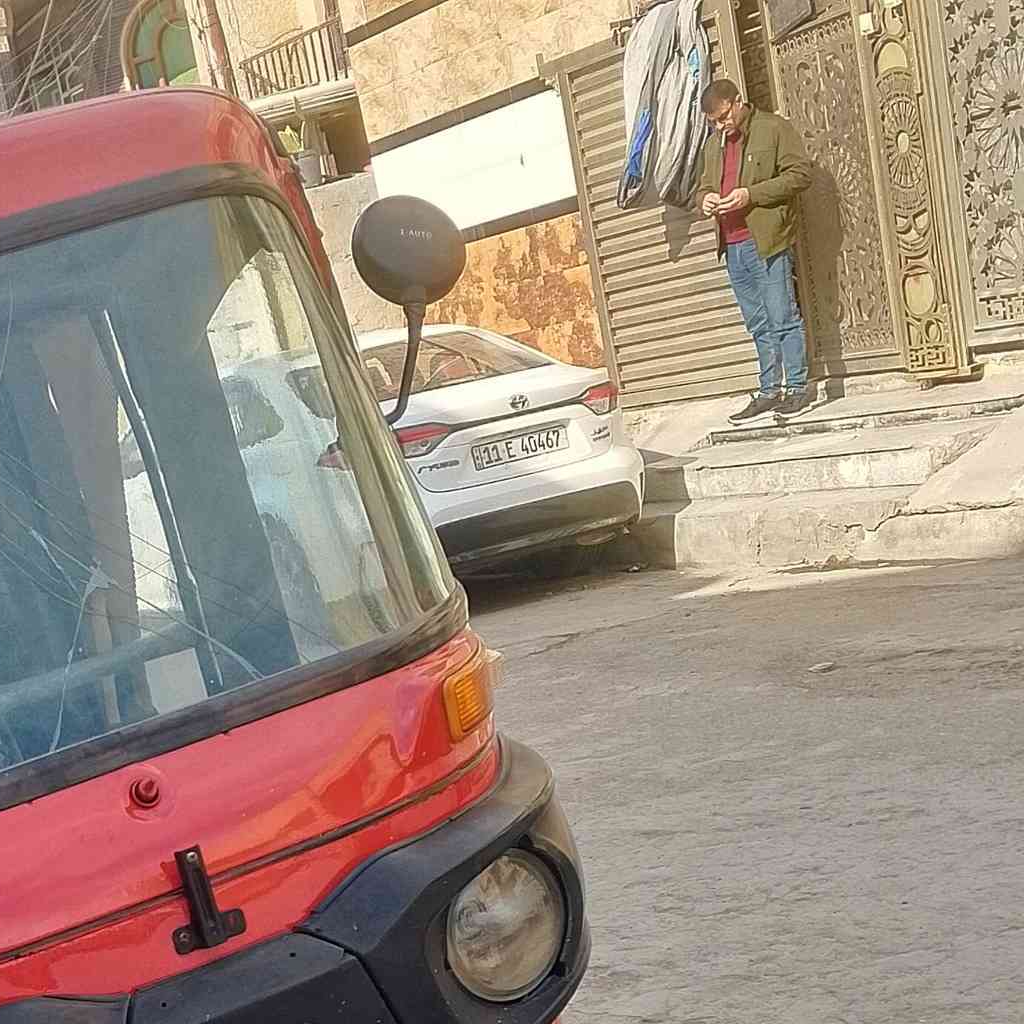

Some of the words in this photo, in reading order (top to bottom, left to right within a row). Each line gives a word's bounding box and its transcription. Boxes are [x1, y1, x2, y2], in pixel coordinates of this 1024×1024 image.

[483, 444, 503, 465] 11
[505, 441, 517, 459] E
[521, 429, 560, 455] 40467
